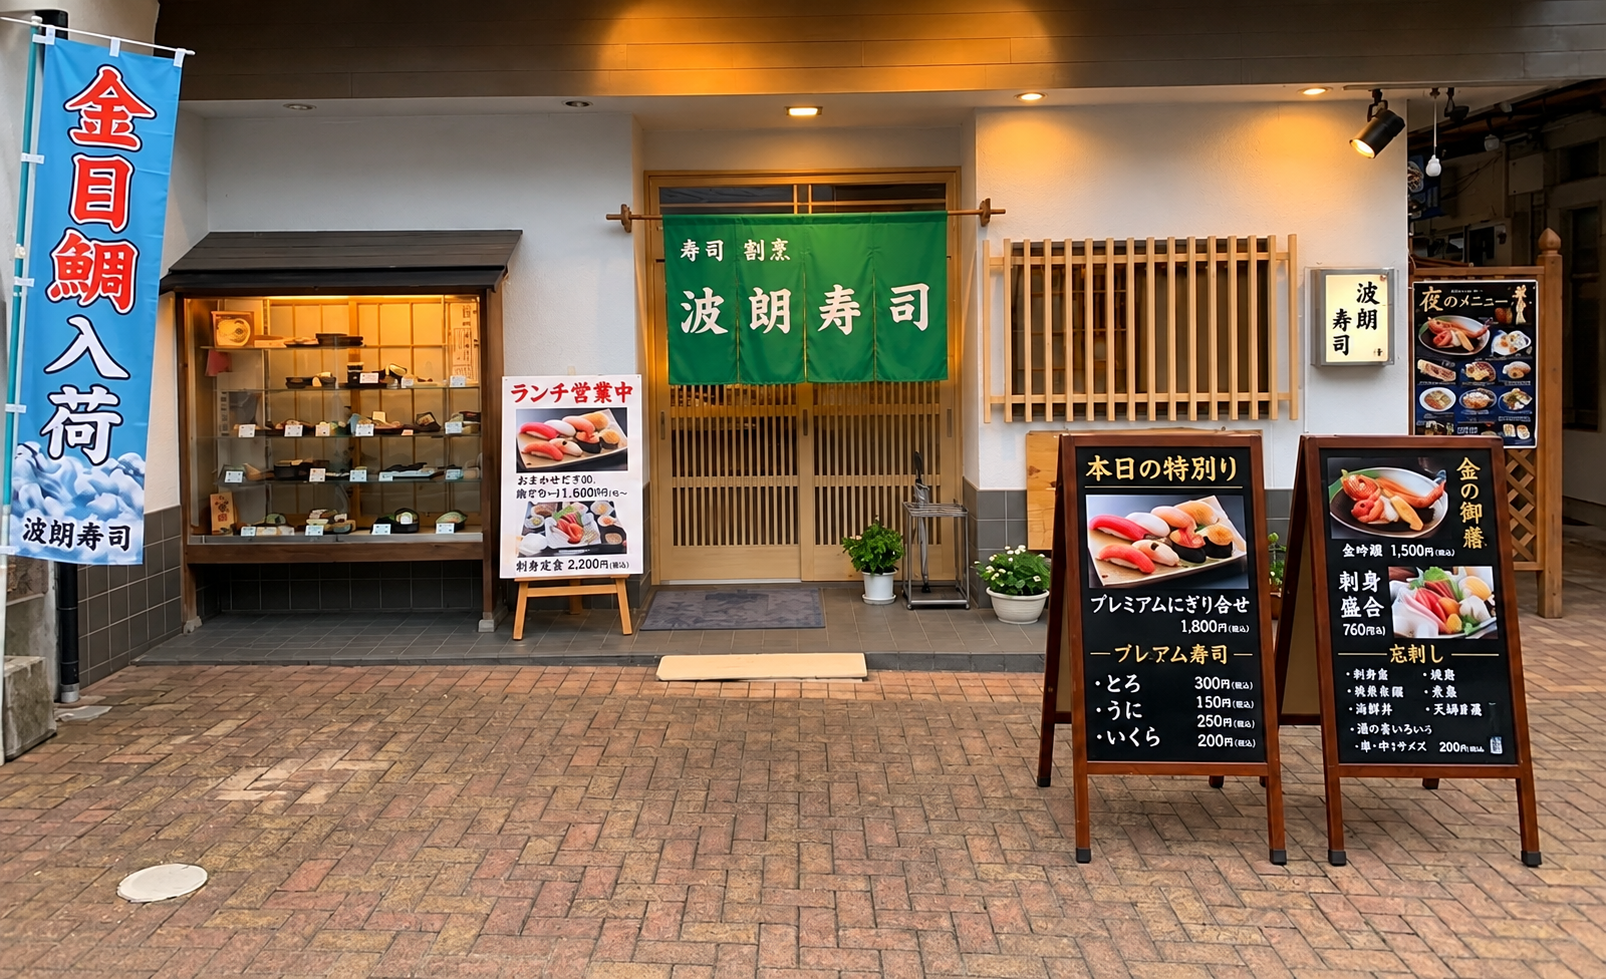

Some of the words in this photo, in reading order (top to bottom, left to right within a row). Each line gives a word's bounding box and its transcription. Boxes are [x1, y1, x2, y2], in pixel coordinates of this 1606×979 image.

[680, 239, 724, 262] 寿司
[40, 64, 157, 466] 金目鯛入荷
[680, 282, 930, 336] 波朗寿司
[1356, 281, 1380, 331] 波朗
[1419, 286, 1508, 312] 夜のメニュー
[1332, 308, 1352, 356] 寿司
[511, 381, 634, 404] ランチ営業中
[1085, 455, 1237, 482] 本日の特別り
[22, 517, 131, 551] 波朗寿司
[1338, 569, 1381, 593] 刺身
[1090, 594, 1250, 614] プレミアムにぎり合せ
[1340, 595, 1385, 618] 盛合
